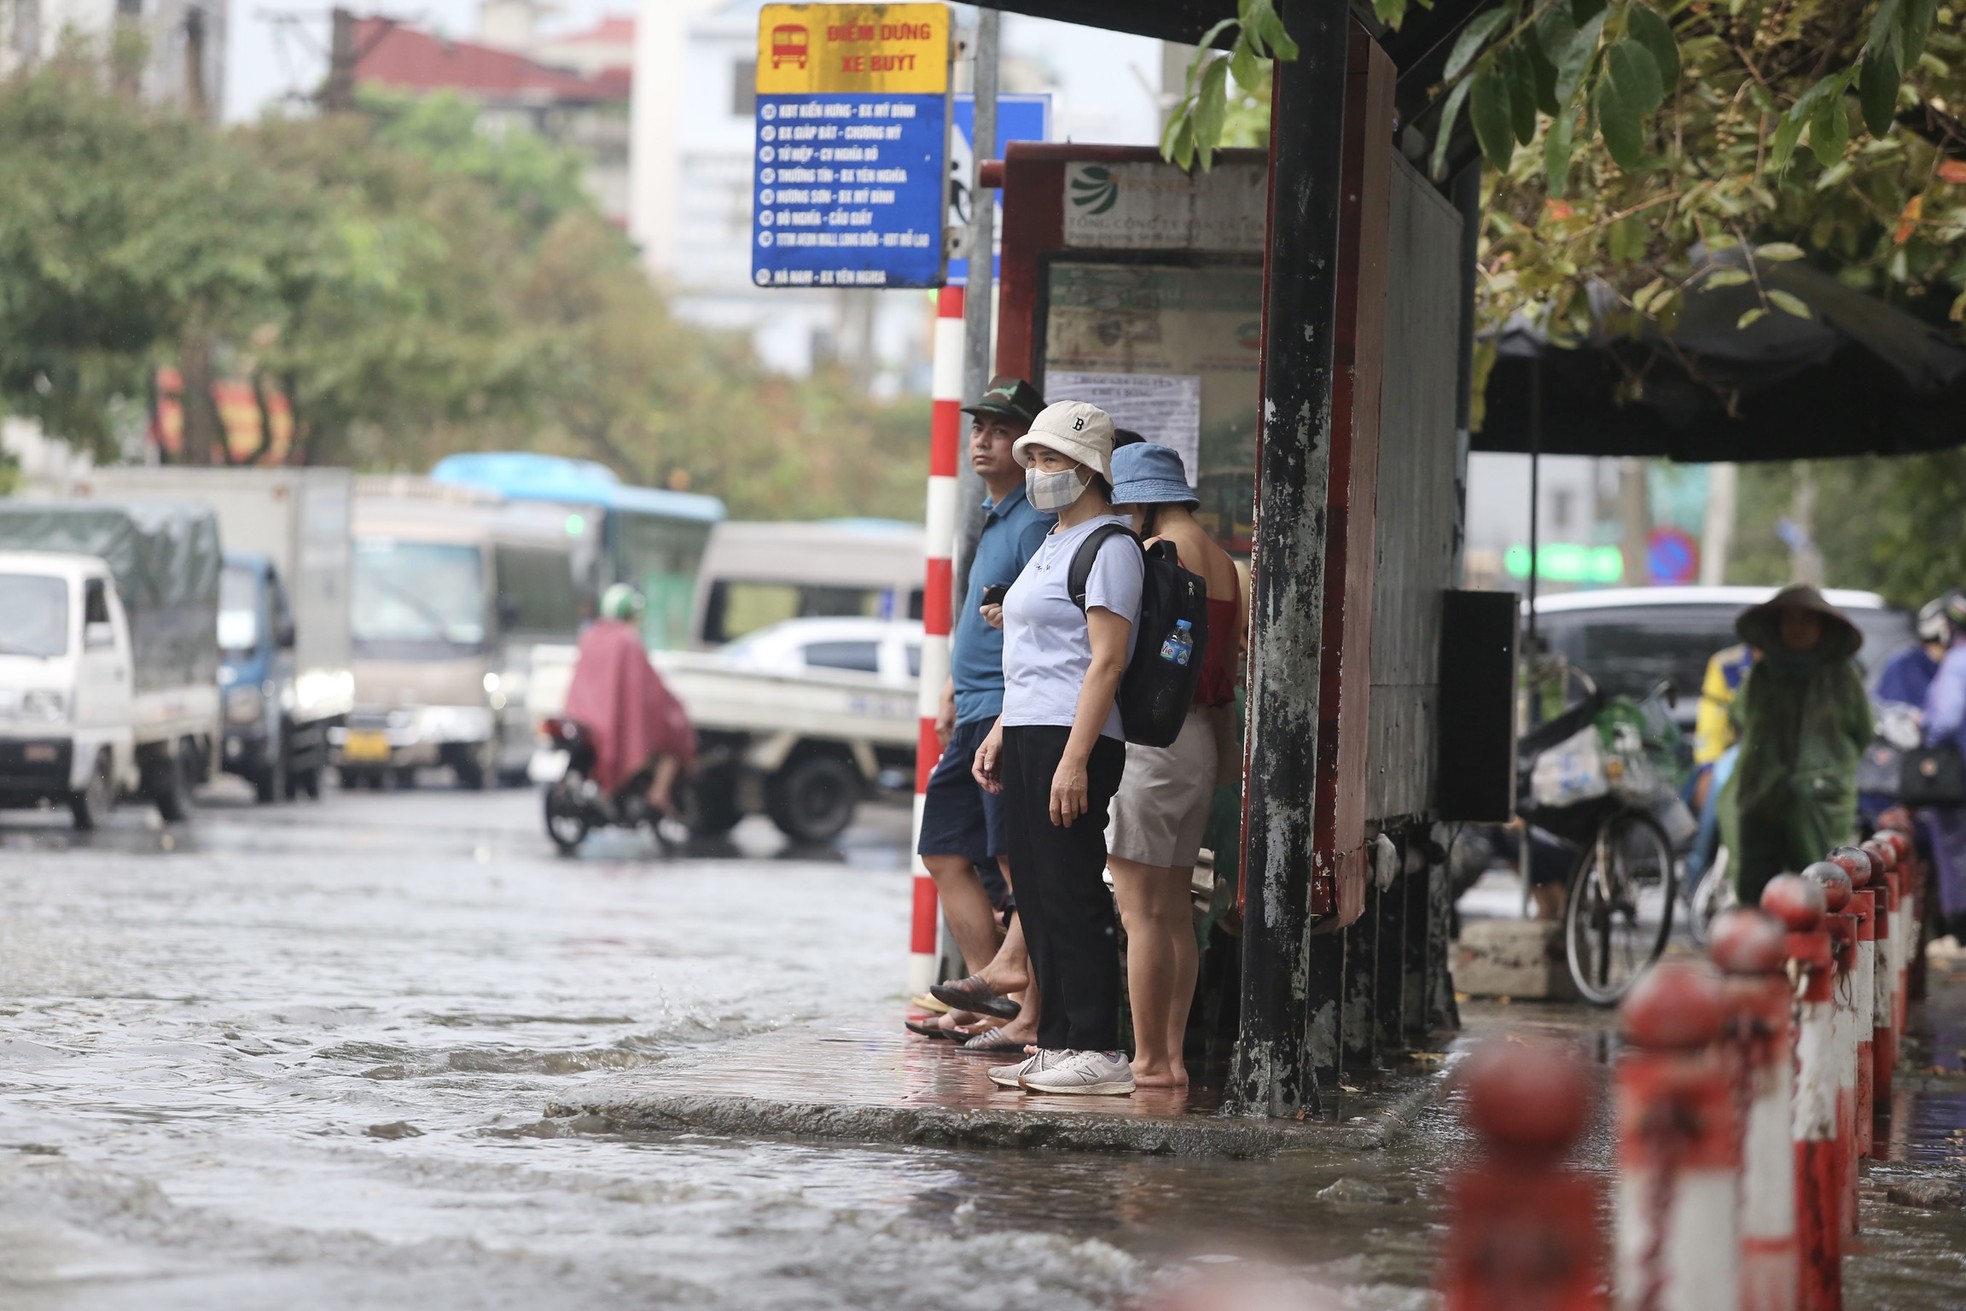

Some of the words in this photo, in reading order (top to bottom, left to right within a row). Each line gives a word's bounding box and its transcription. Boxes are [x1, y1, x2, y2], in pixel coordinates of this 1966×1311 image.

[841, 56, 864, 72] XE
[870, 49, 916, 71] BUÝT
[1072, 417, 1084, 431] B
